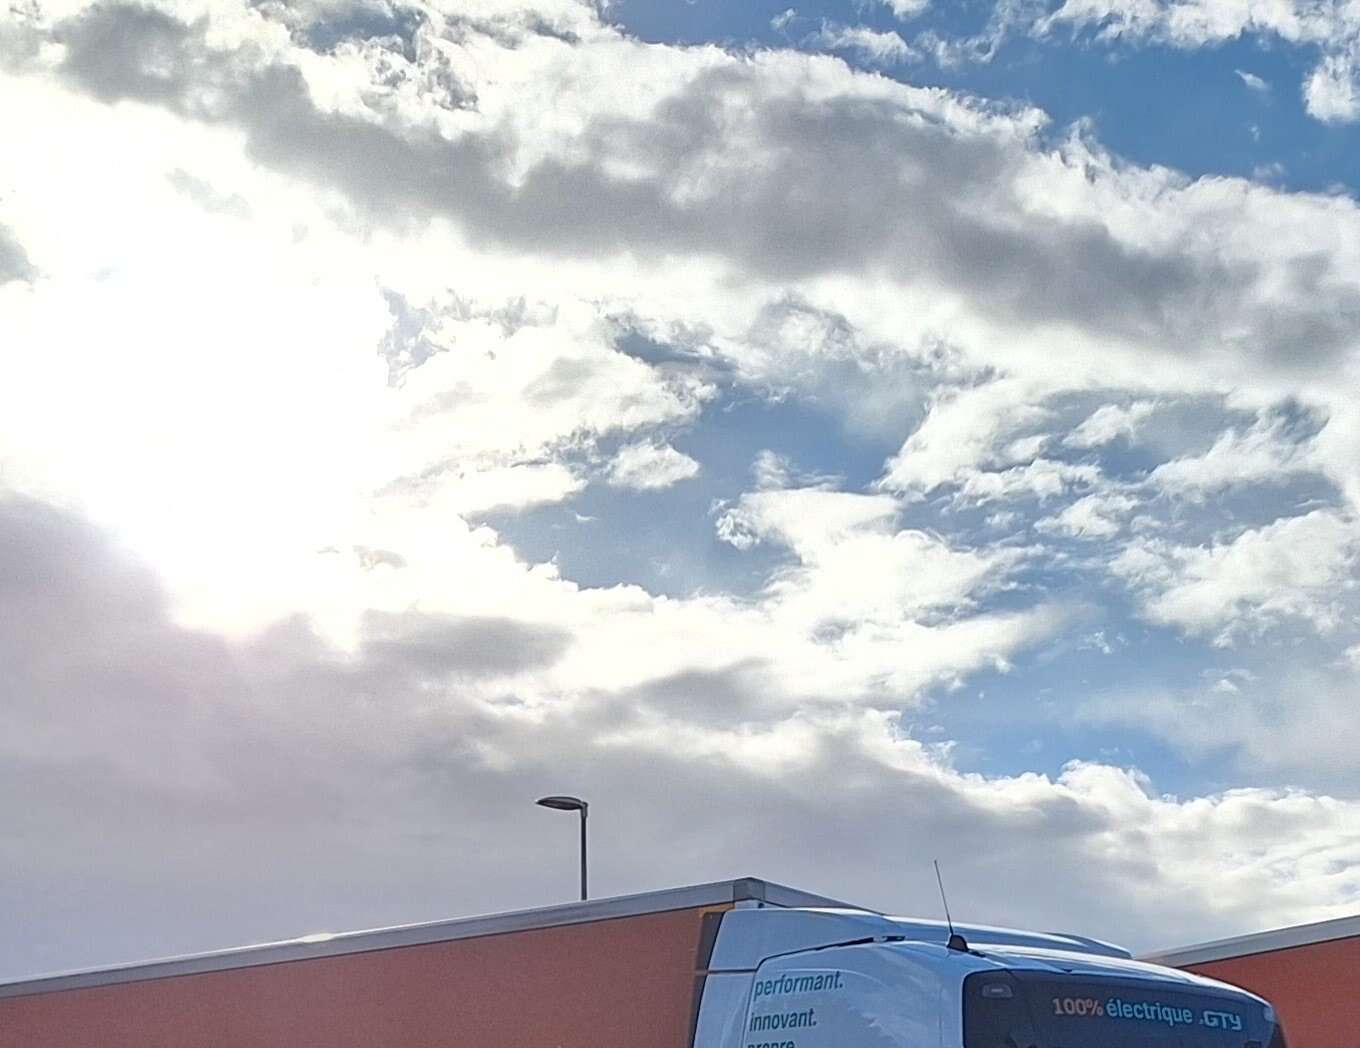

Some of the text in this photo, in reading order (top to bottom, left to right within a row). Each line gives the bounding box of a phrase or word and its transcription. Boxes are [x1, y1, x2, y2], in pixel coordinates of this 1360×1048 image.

[753, 971, 843, 1001] performant.
[749, 1008, 817, 1032] innovant.
[1053, 998, 1104, 1017] 100%
[1106, 999, 1192, 1026] électrique
